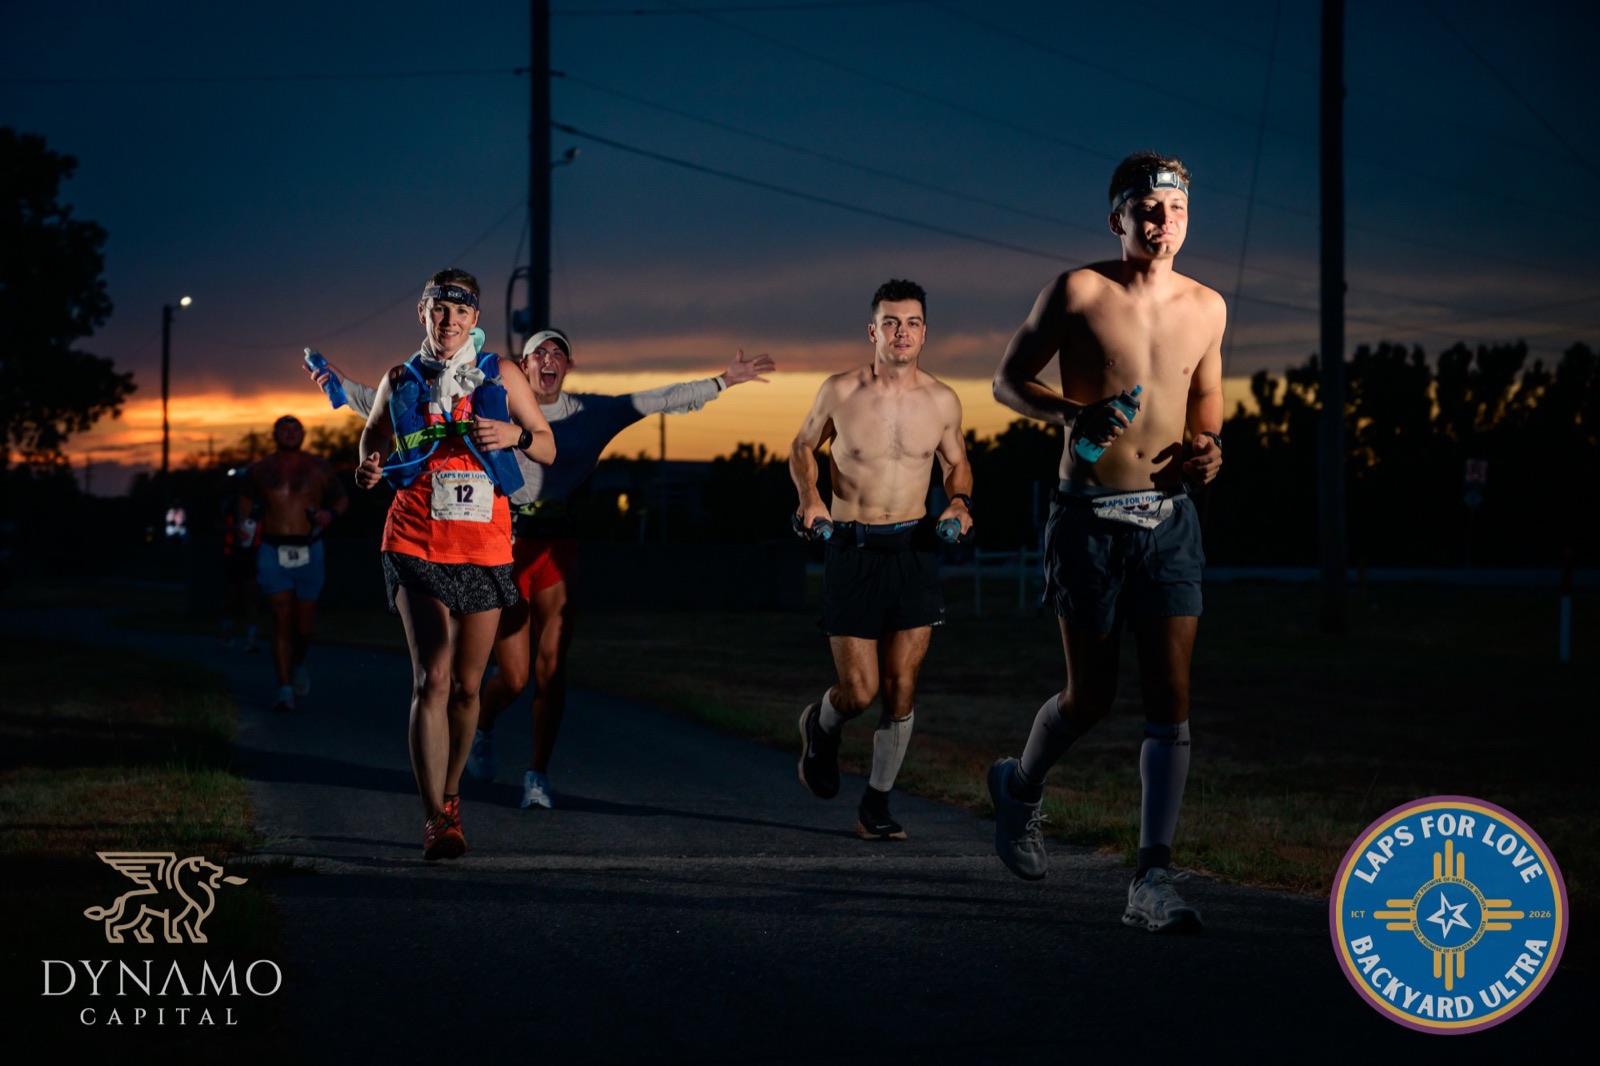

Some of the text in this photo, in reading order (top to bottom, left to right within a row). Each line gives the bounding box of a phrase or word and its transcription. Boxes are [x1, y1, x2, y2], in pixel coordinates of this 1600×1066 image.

[454, 484, 474, 503] 12
[1103, 499, 1123, 508] LAPS
[1125, 496, 1140, 505] FOR
